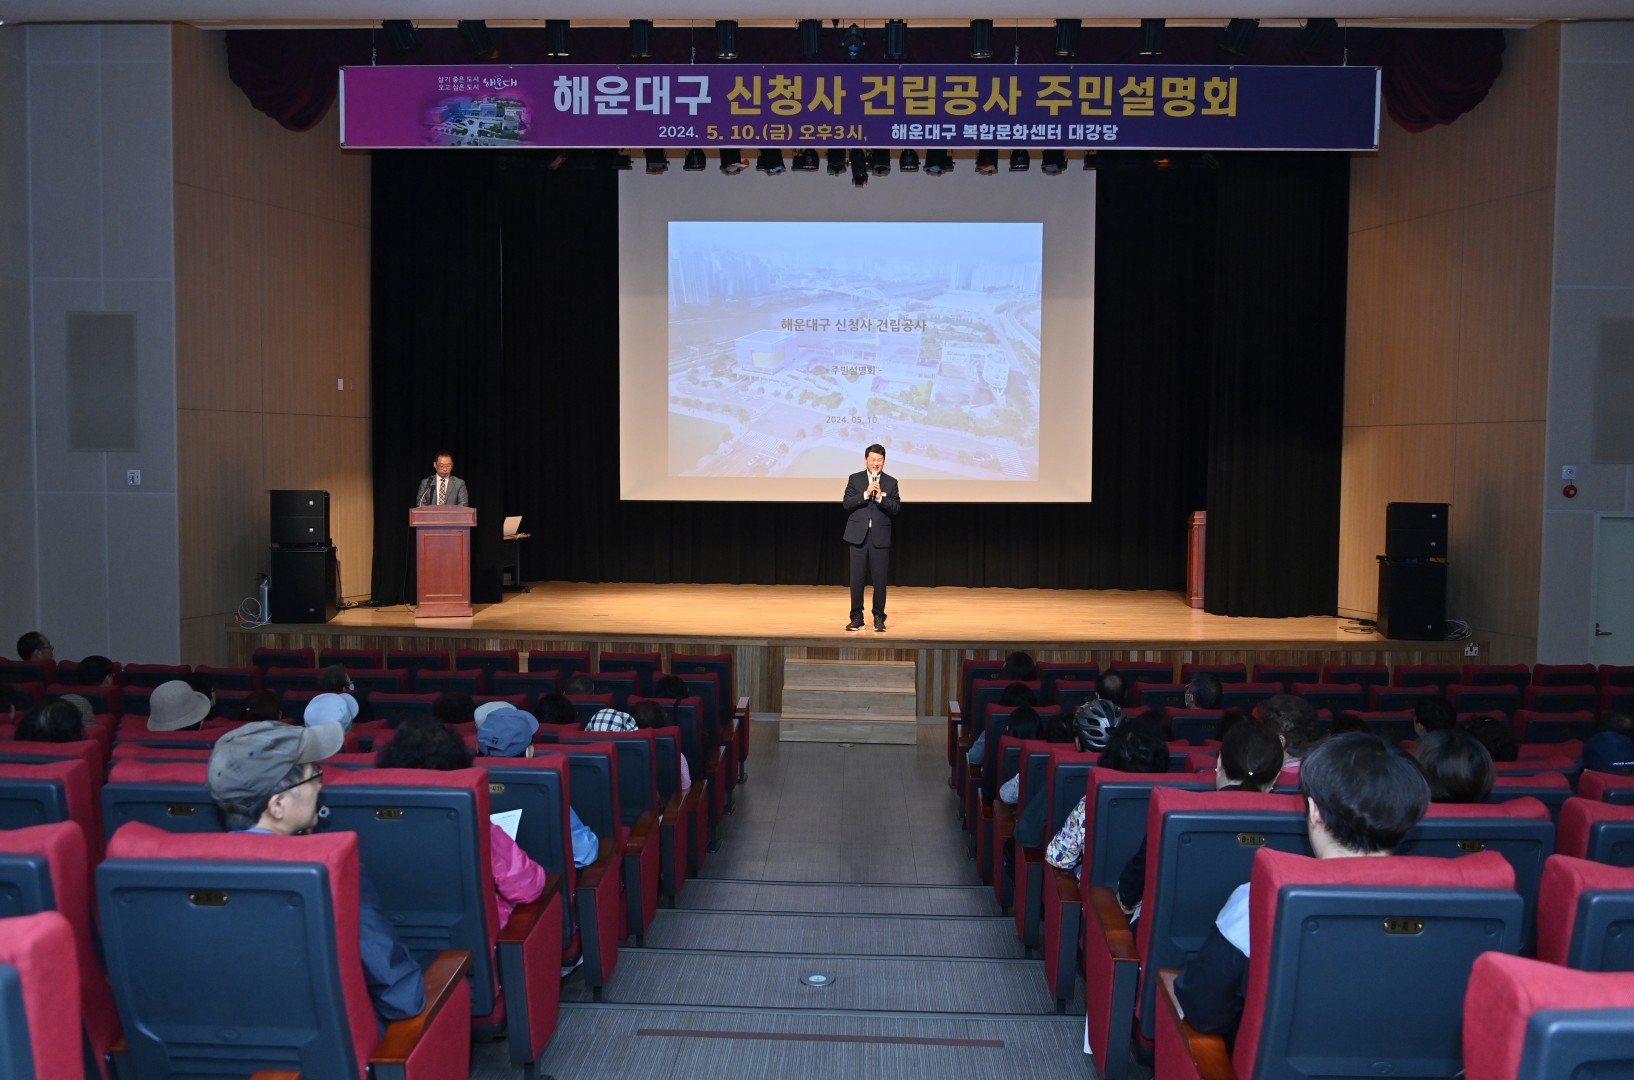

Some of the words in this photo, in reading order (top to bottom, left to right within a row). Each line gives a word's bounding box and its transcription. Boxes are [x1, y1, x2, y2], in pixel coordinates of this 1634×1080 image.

[452, 76, 465, 84] 좋은
[482, 74, 518, 90] 해운대
[553, 75, 712, 116] 해운대구
[726, 74, 847, 116] 신청사
[859, 75, 1022, 116] 건립공사
[1035, 75, 1238, 118] 주민설명회
[658, 125, 699, 138] 2024.
[891, 123, 957, 140] 해운대구
[962, 123, 1062, 141] 복합문화센터
[1068, 124, 1119, 141] 대강당
[780, 318, 831, 332] 해운대구
[835, 318, 873, 332] 신청사
[876, 318, 927, 333] 건립공사
[831, 365, 876, 376] 주민설명회
